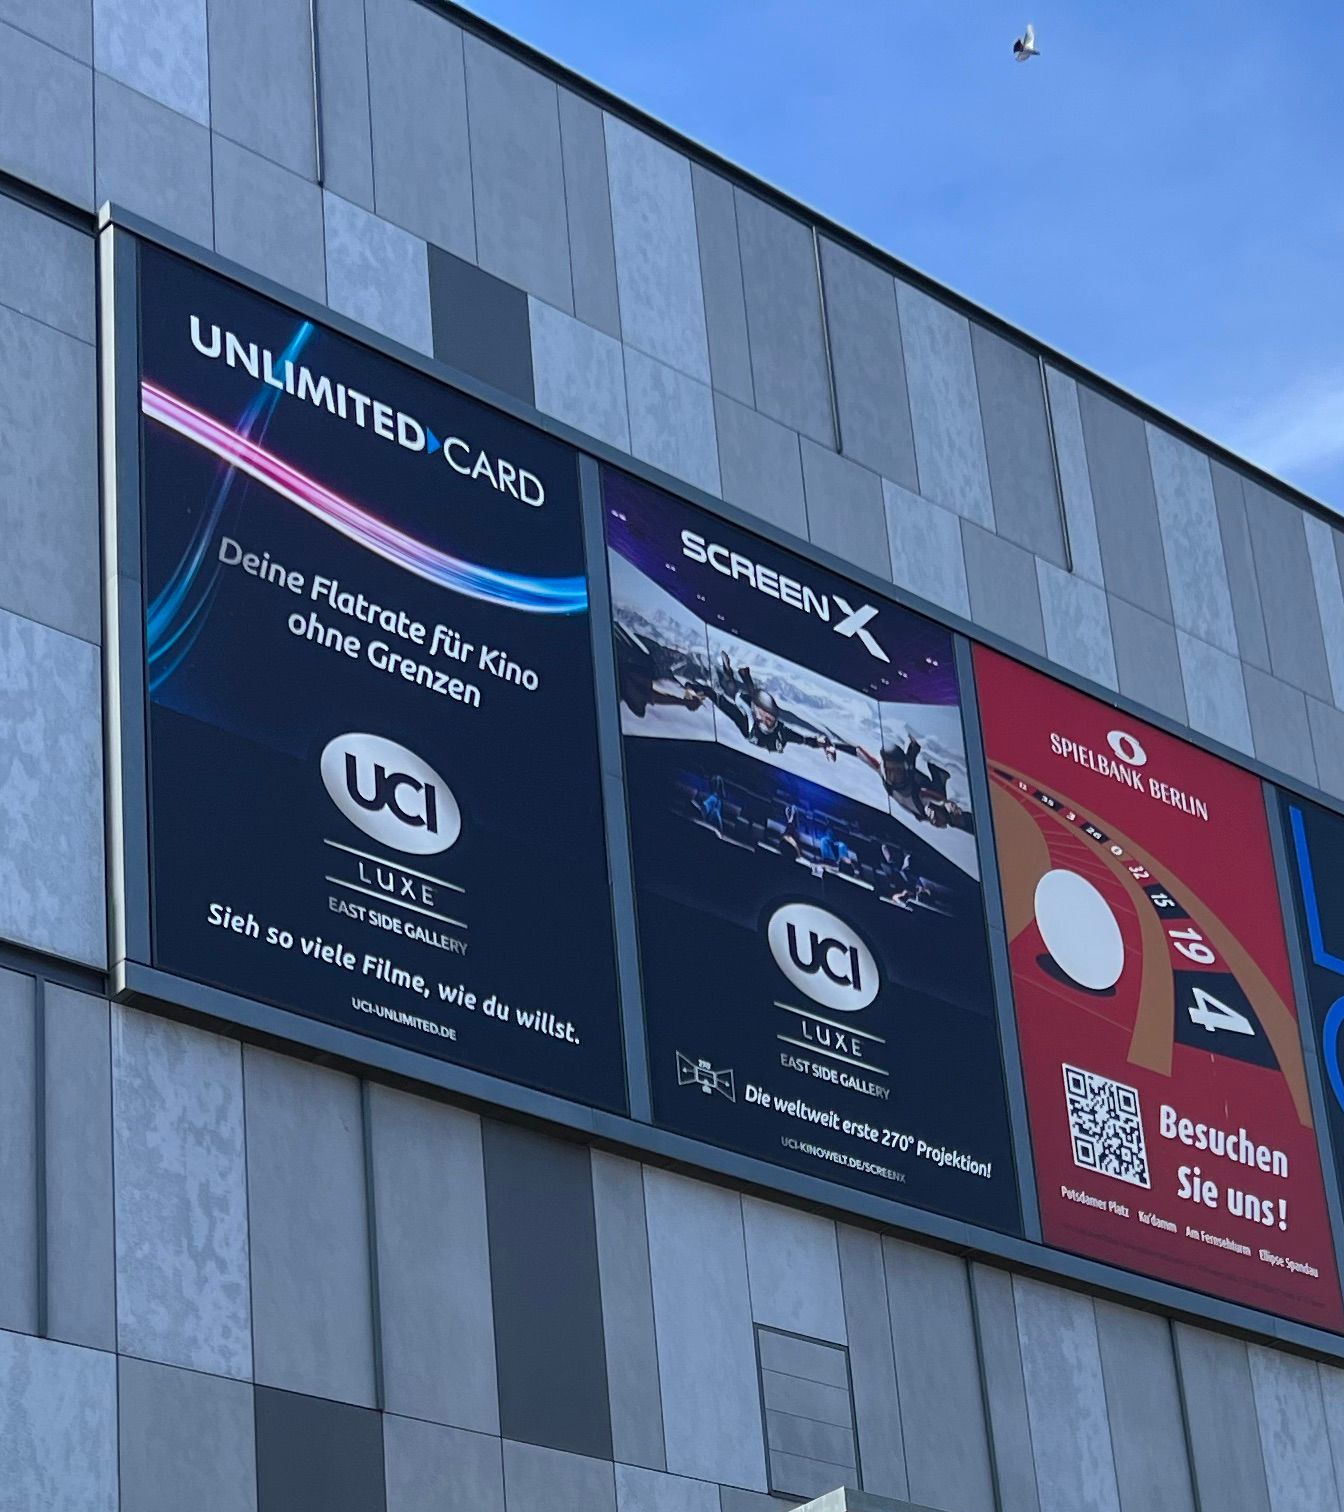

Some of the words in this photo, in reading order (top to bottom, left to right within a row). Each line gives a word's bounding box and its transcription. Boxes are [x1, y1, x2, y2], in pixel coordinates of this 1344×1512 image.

[188, 315, 427, 453] UNLIMITED
[442, 436, 546, 508] CARD
[218, 536, 305, 595] Deine
[310, 574, 424, 645] Flatrate
[429, 624, 474, 656] für
[478, 645, 540, 692] Kino
[288, 612, 361, 659] ohne
[367, 640, 481, 708] Grenzen
[345, 752, 438, 834] UCI
[1050, 732, 1145, 793] SPIELBANK
[1149, 777, 1209, 821] BERLIN
[359, 861, 435, 906] LUXE
[1128, 865, 1150, 880] 32
[1151, 892, 1176, 909] 15
[328, 896, 367, 922] EAST
[368, 910, 403, 935] SIDE
[404, 922, 469, 956] GALLERY
[786, 922, 862, 992] UCI
[1169, 927, 1216, 965] 19
[207, 903, 260, 939] Sieh
[266, 924, 294, 950] so
[300, 935, 356, 971] viele
[362, 955, 431, 998] Filme,
[437, 981, 477, 1011] wie
[482, 994, 509, 1022] du
[515, 1007, 581, 1046] willst.
[351, 997, 458, 1042] UCI-UNLIMITED.DE
[801, 1019, 863, 1058] LUXE
[1188, 987, 1256, 1036] 4
[780, 1052, 809, 1075] EAST
[812, 1063, 838, 1085] SIDE
[839, 1072, 890, 1101] GALLERY
[745, 1084, 771, 1108] Die
[773, 1095, 840, 1132] weltweit
[842, 1118, 879, 1143] erste
[880, 1128, 914, 1152] 270°
[916, 1140, 992, 1179] Projektion!
[1159, 1104, 1289, 1179] Besuchen
[1061, 1185, 1107, 1211] Potsdamer
[1108, 1200, 1130, 1218] Platz
[1185, 1226, 1200, 1240] Am
[1200, 1230, 1252, 1257] Fernsehturm
[1284, 1257, 1319, 1278] Spandau
[1177, 1166, 1218, 1208] Sie
[1227, 1187, 1288, 1231] uns!
